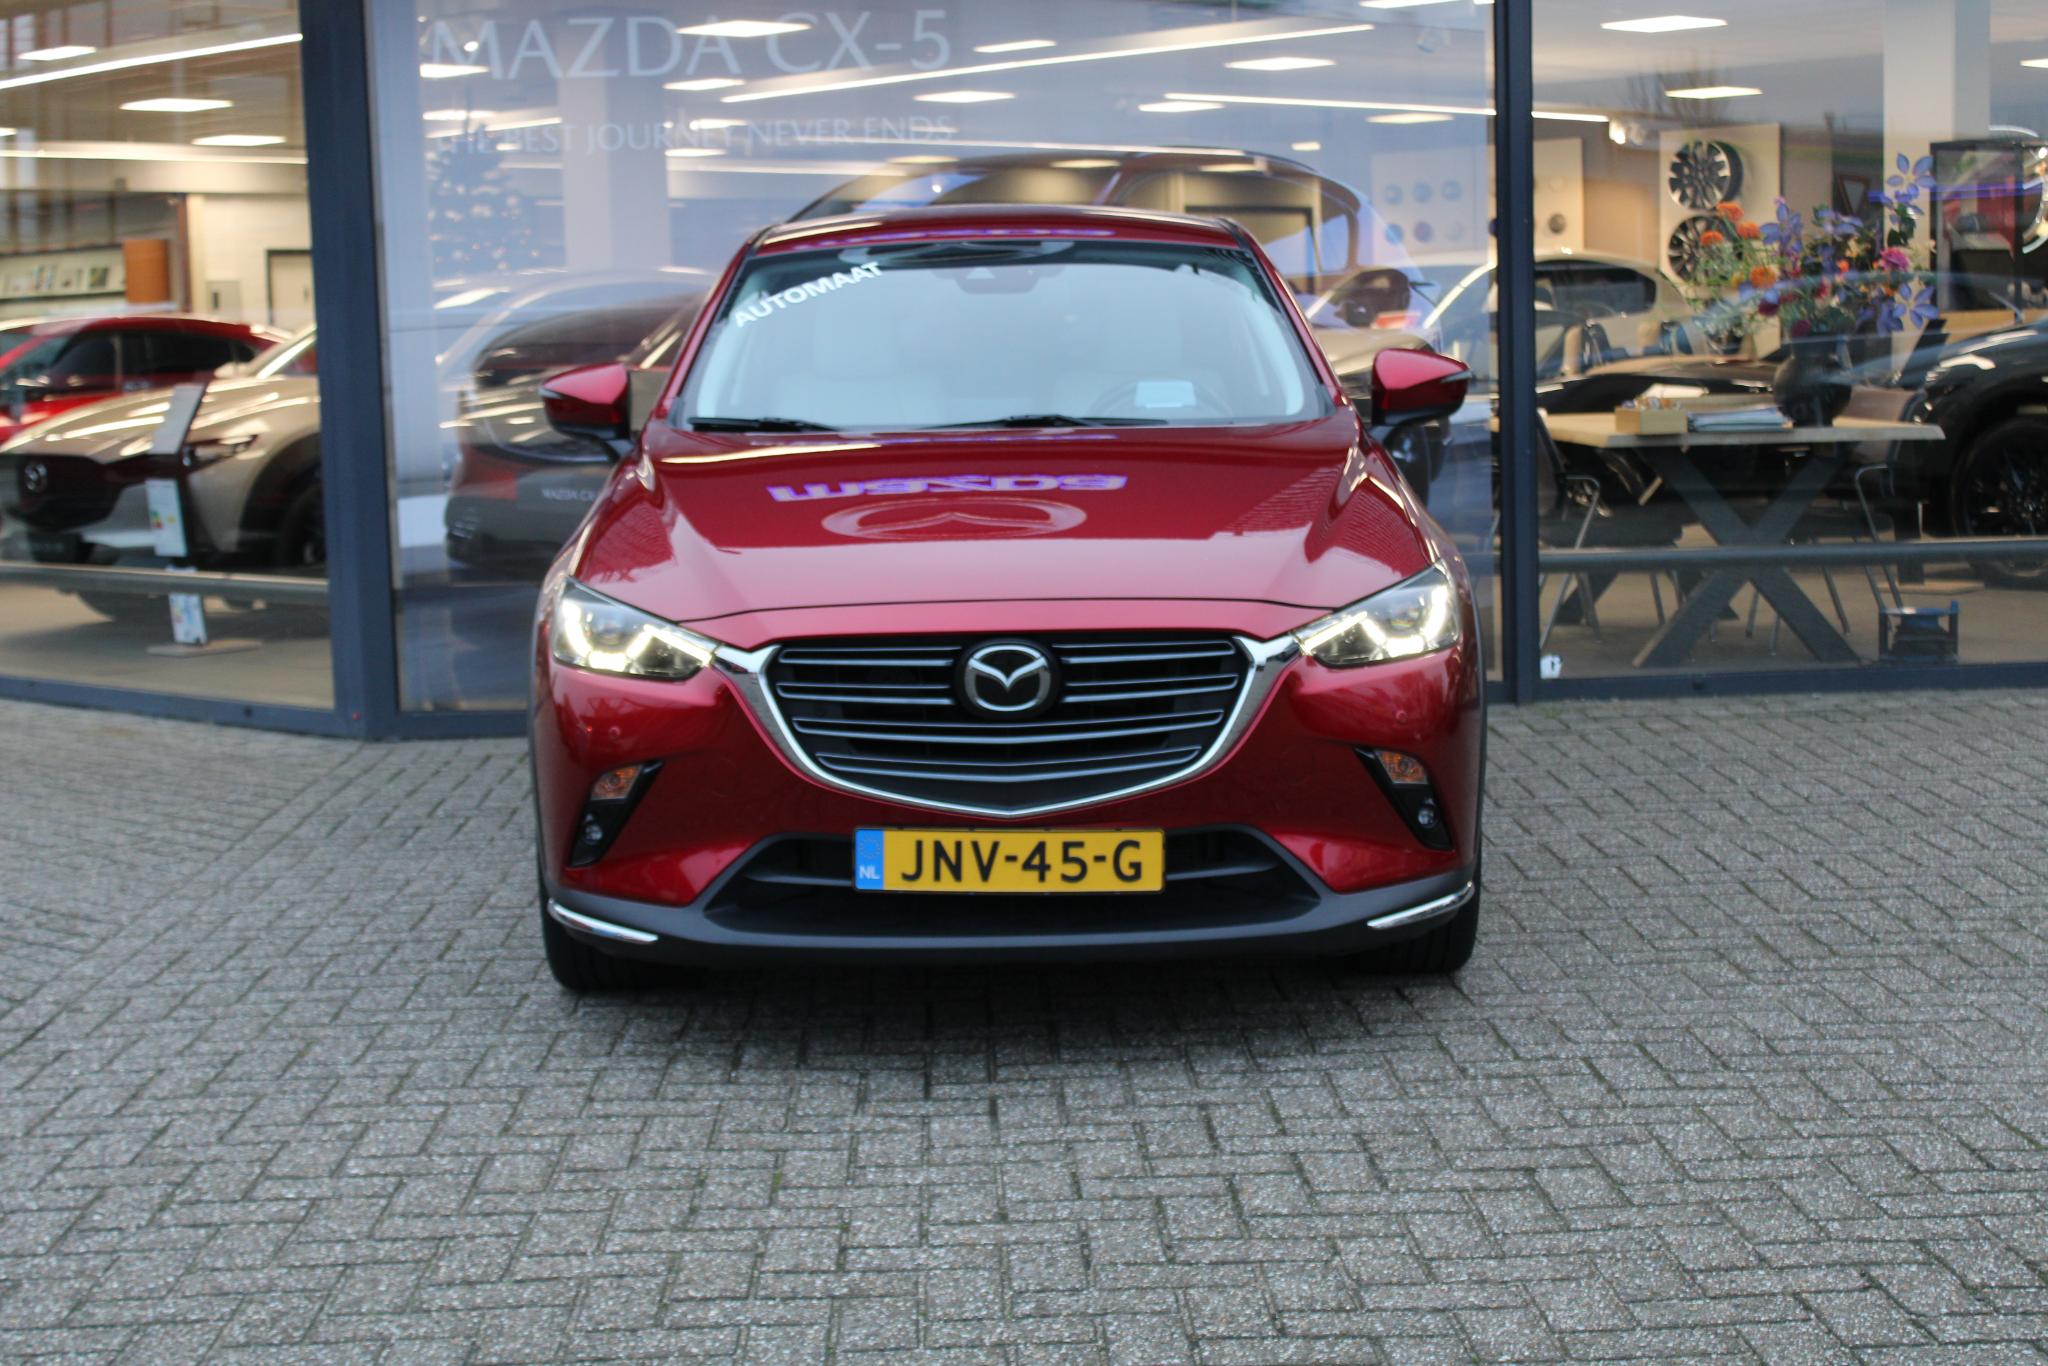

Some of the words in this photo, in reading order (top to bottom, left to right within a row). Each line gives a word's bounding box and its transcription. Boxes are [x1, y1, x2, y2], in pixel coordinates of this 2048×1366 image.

[431, 15, 741, 81] MAZDA
[766, 9, 951, 74] CX-5
[502, 122, 578, 153] BEST
[748, 116, 849, 148] NEVER
[862, 113, 953, 143] ENDS
[735, 261, 884, 328] AUTOMAAT
[859, 865, 881, 880] NL
[901, 839, 1143, 883] JNV-45-G
